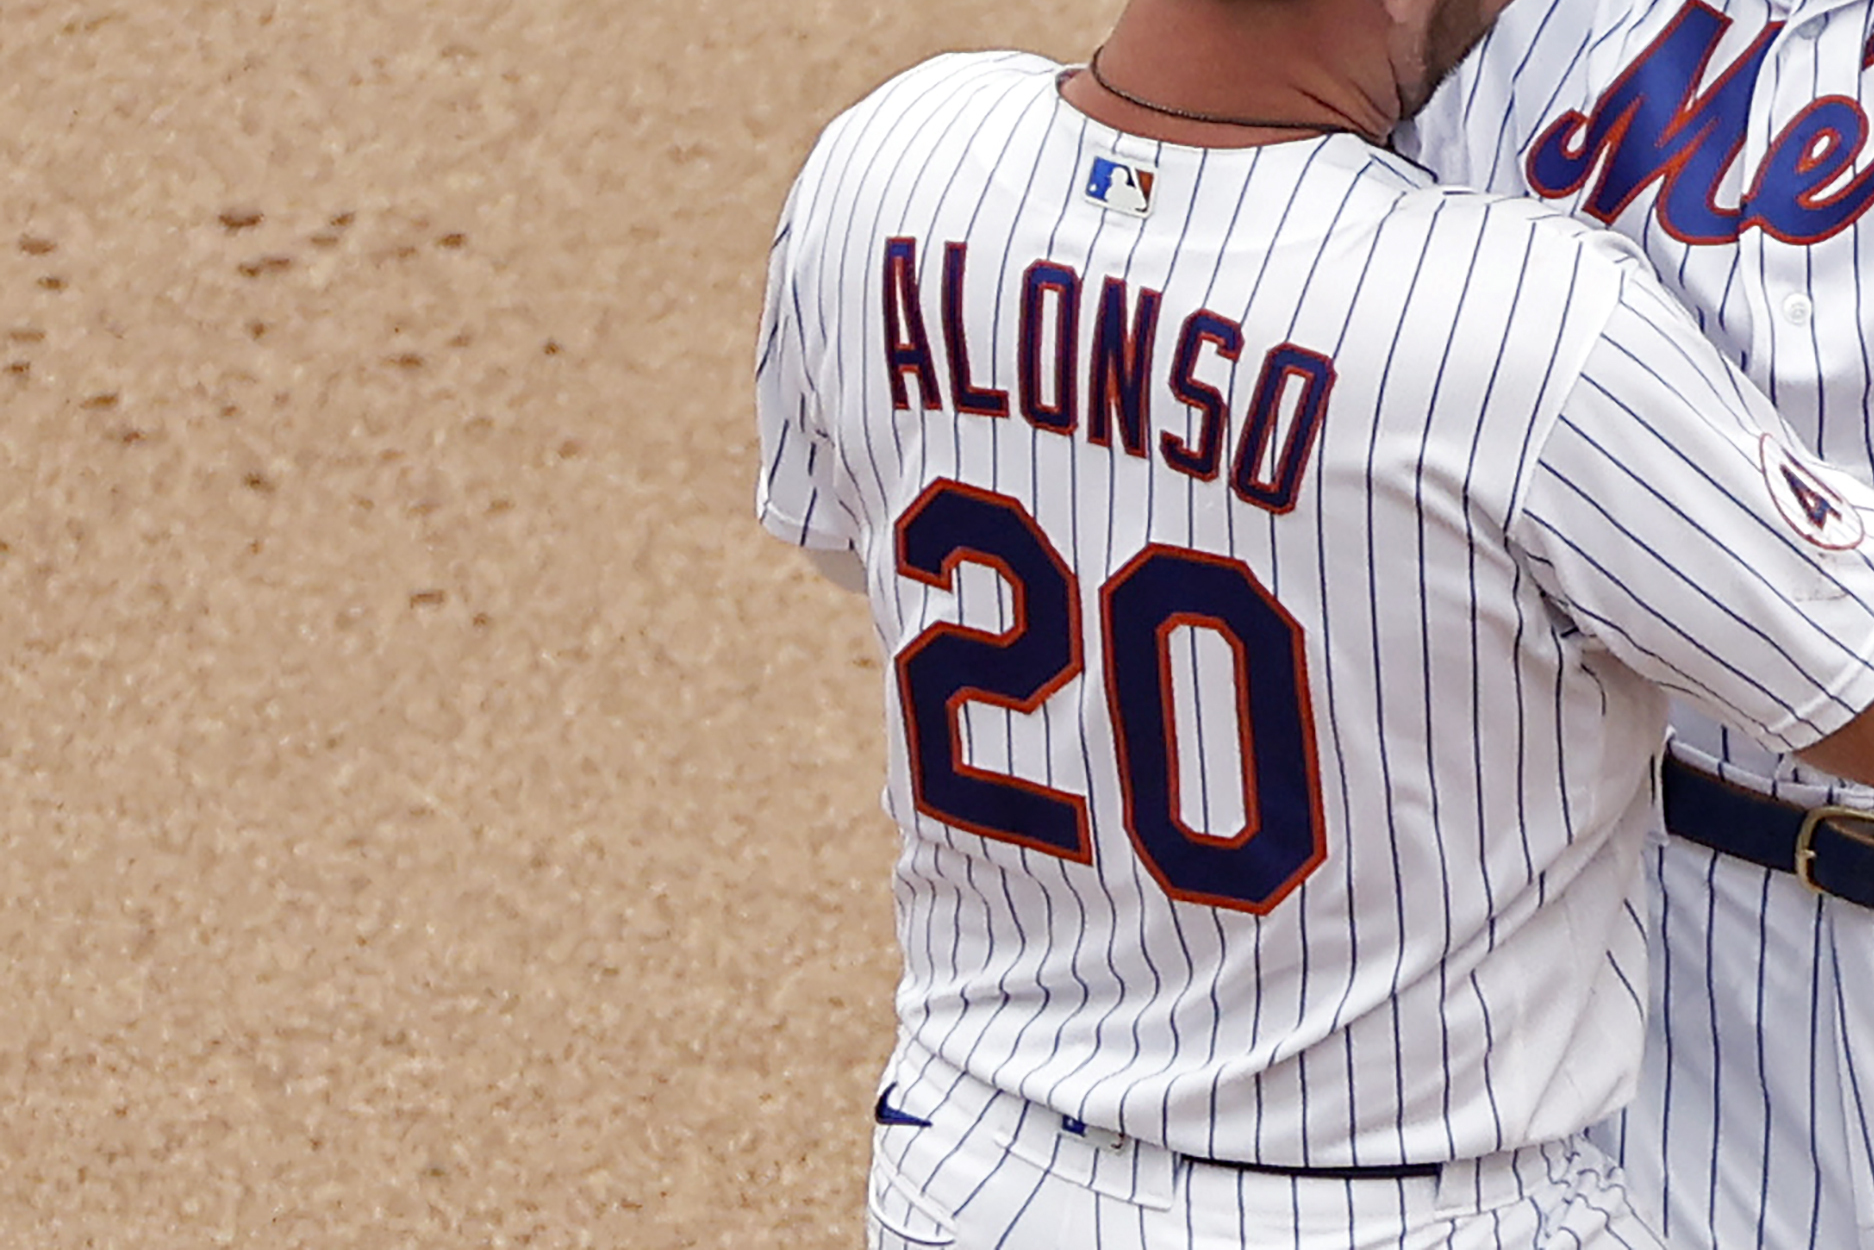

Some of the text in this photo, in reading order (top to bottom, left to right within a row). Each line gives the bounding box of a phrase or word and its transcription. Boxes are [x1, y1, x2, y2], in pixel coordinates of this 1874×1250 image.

[884, 236, 1337, 516] ALONSO
[1779, 462, 1842, 531] 4
[894, 477, 1327, 916] 20
